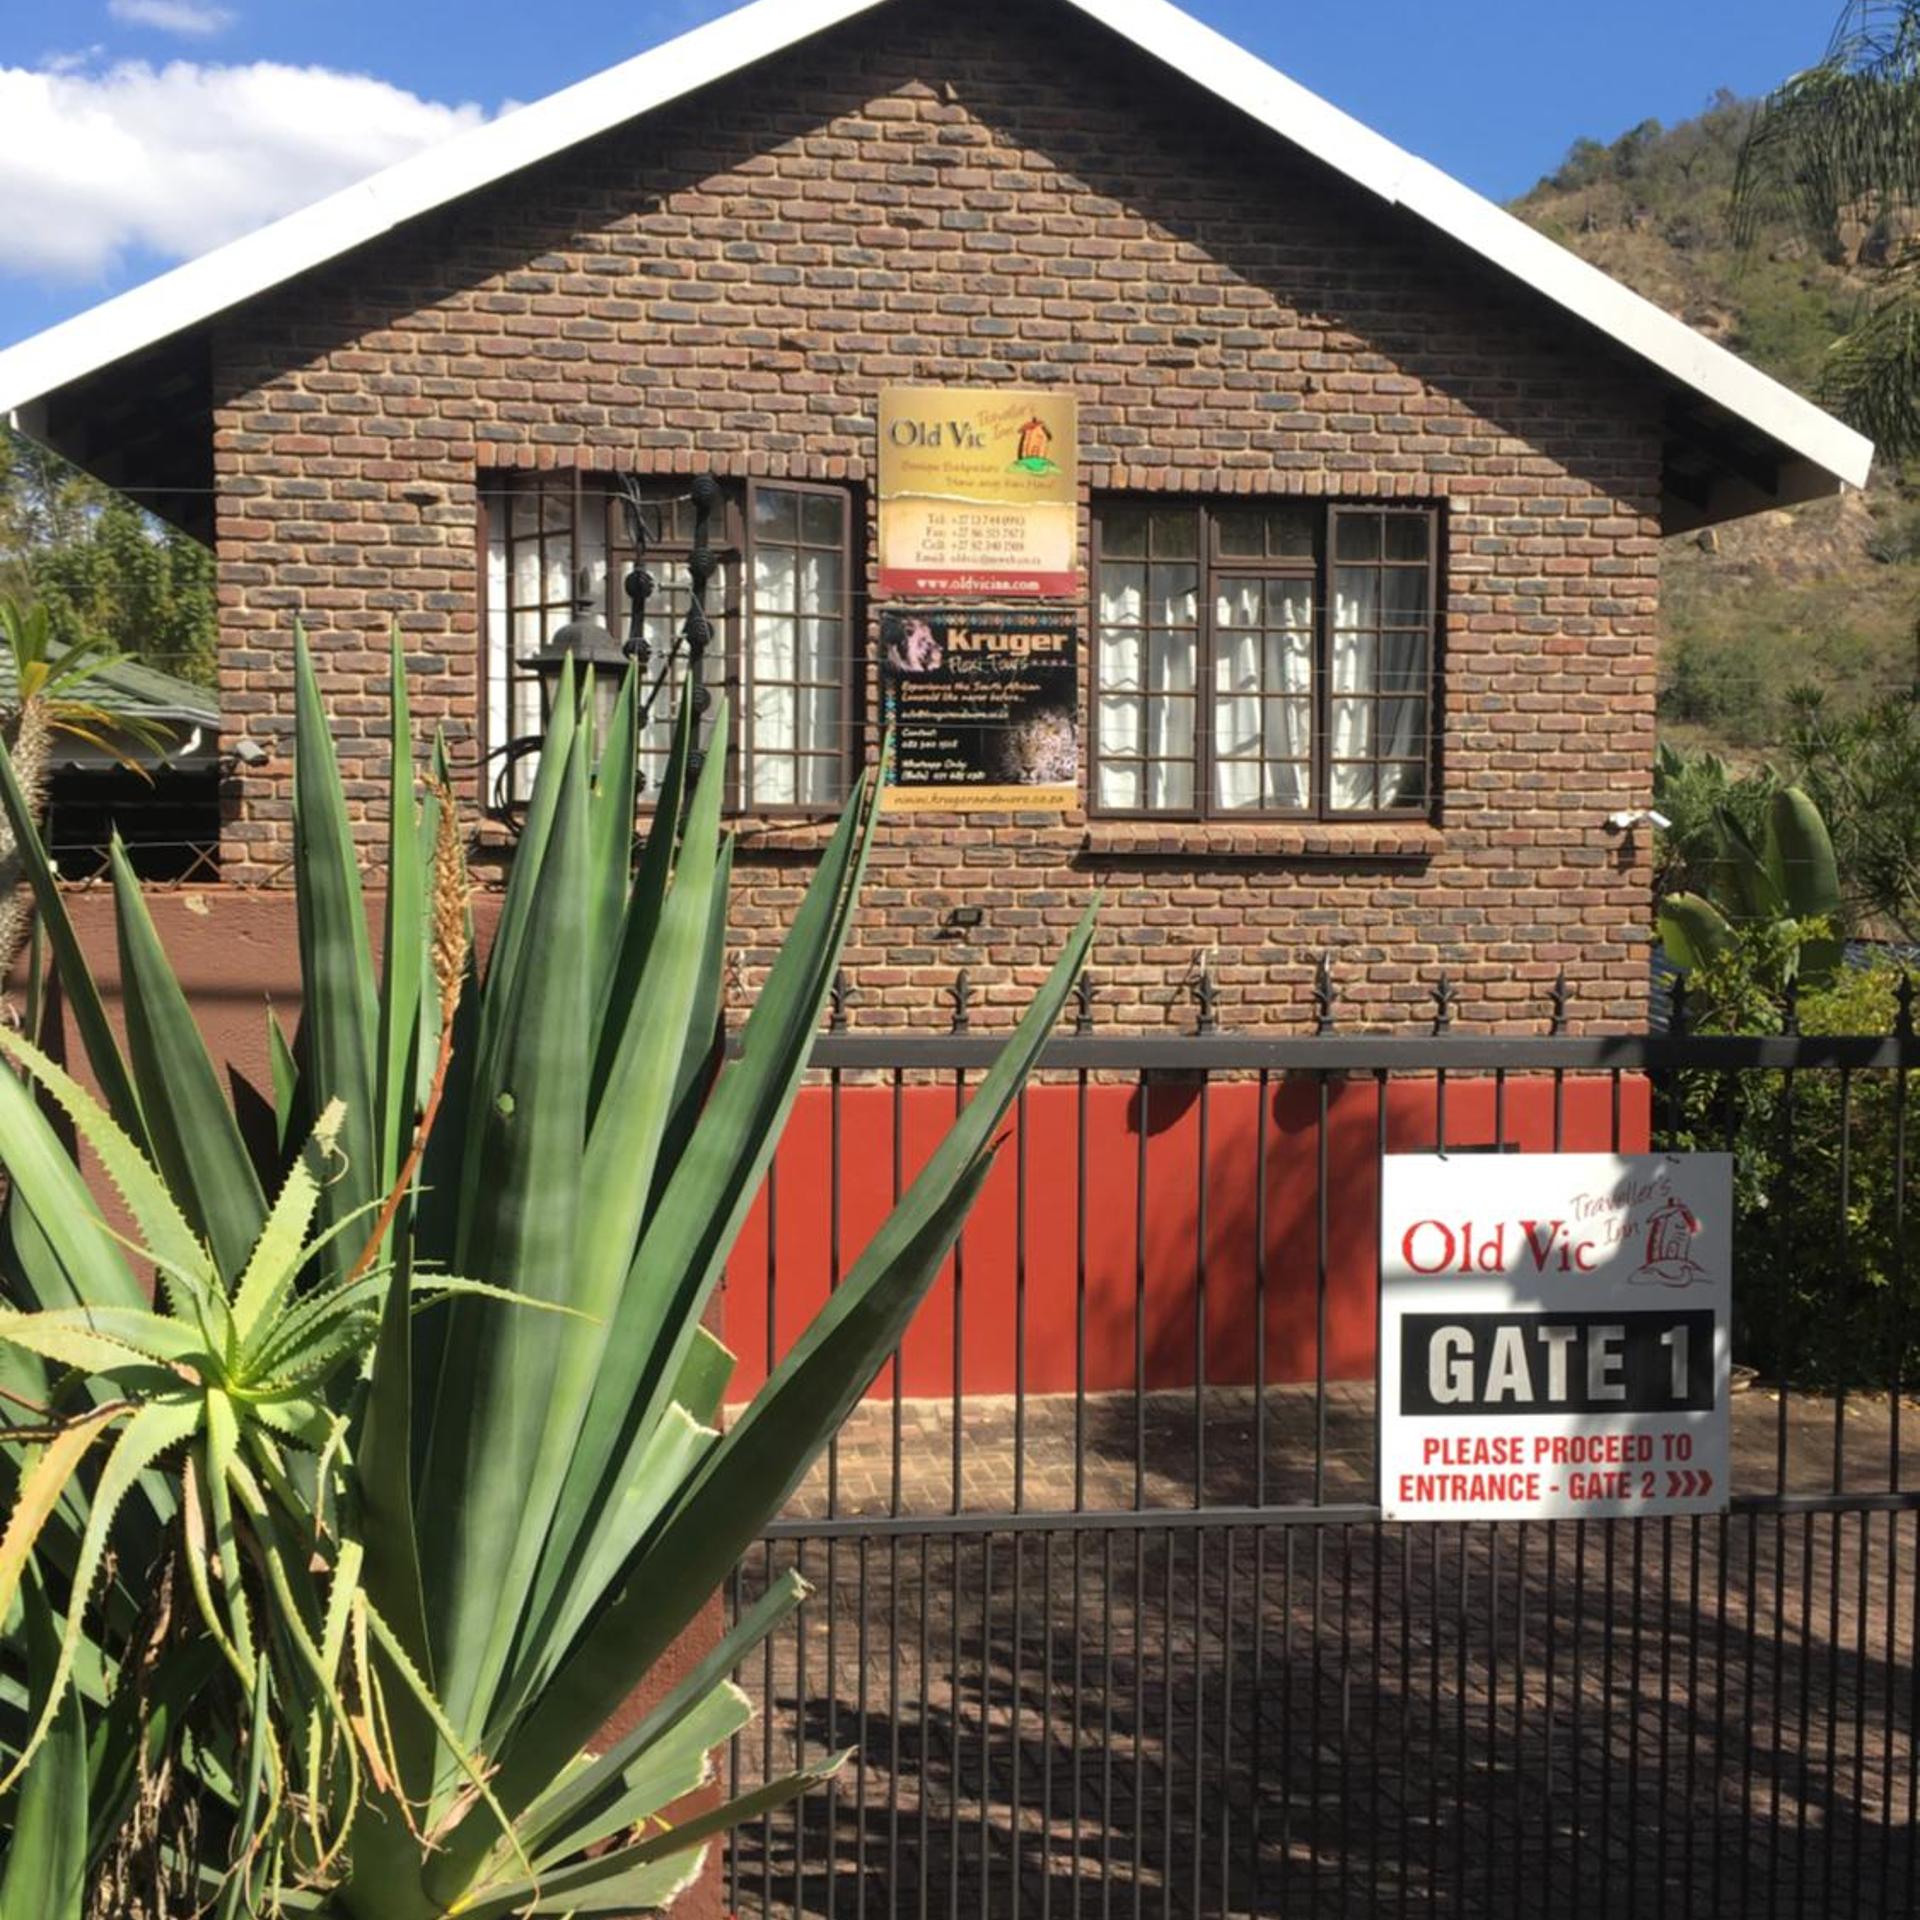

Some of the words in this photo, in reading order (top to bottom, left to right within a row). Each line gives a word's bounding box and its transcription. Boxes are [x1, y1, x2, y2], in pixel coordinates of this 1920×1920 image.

[890, 419, 942, 447] Old
[948, 420, 986, 447] Vic
[947, 628, 1069, 657] Kruger
[1571, 1177, 1672, 1222] Traveller's
[1402, 1220, 1505, 1275] Old
[1519, 1220, 1597, 1273] Vic
[1603, 1218, 1640, 1246] Inn
[1428, 1325, 1627, 1404] GATE
[1660, 1325, 1689, 1400] 1
[1423, 1436, 1524, 1466] PLEASE
[1534, 1434, 1652, 1464] PROCEED
[1662, 1433, 1692, 1462] TO
[1399, 1472, 1541, 1502] ENTRANCE
[1569, 1471, 1632, 1501] GATE
[1640, 1470, 1657, 1499] 2
